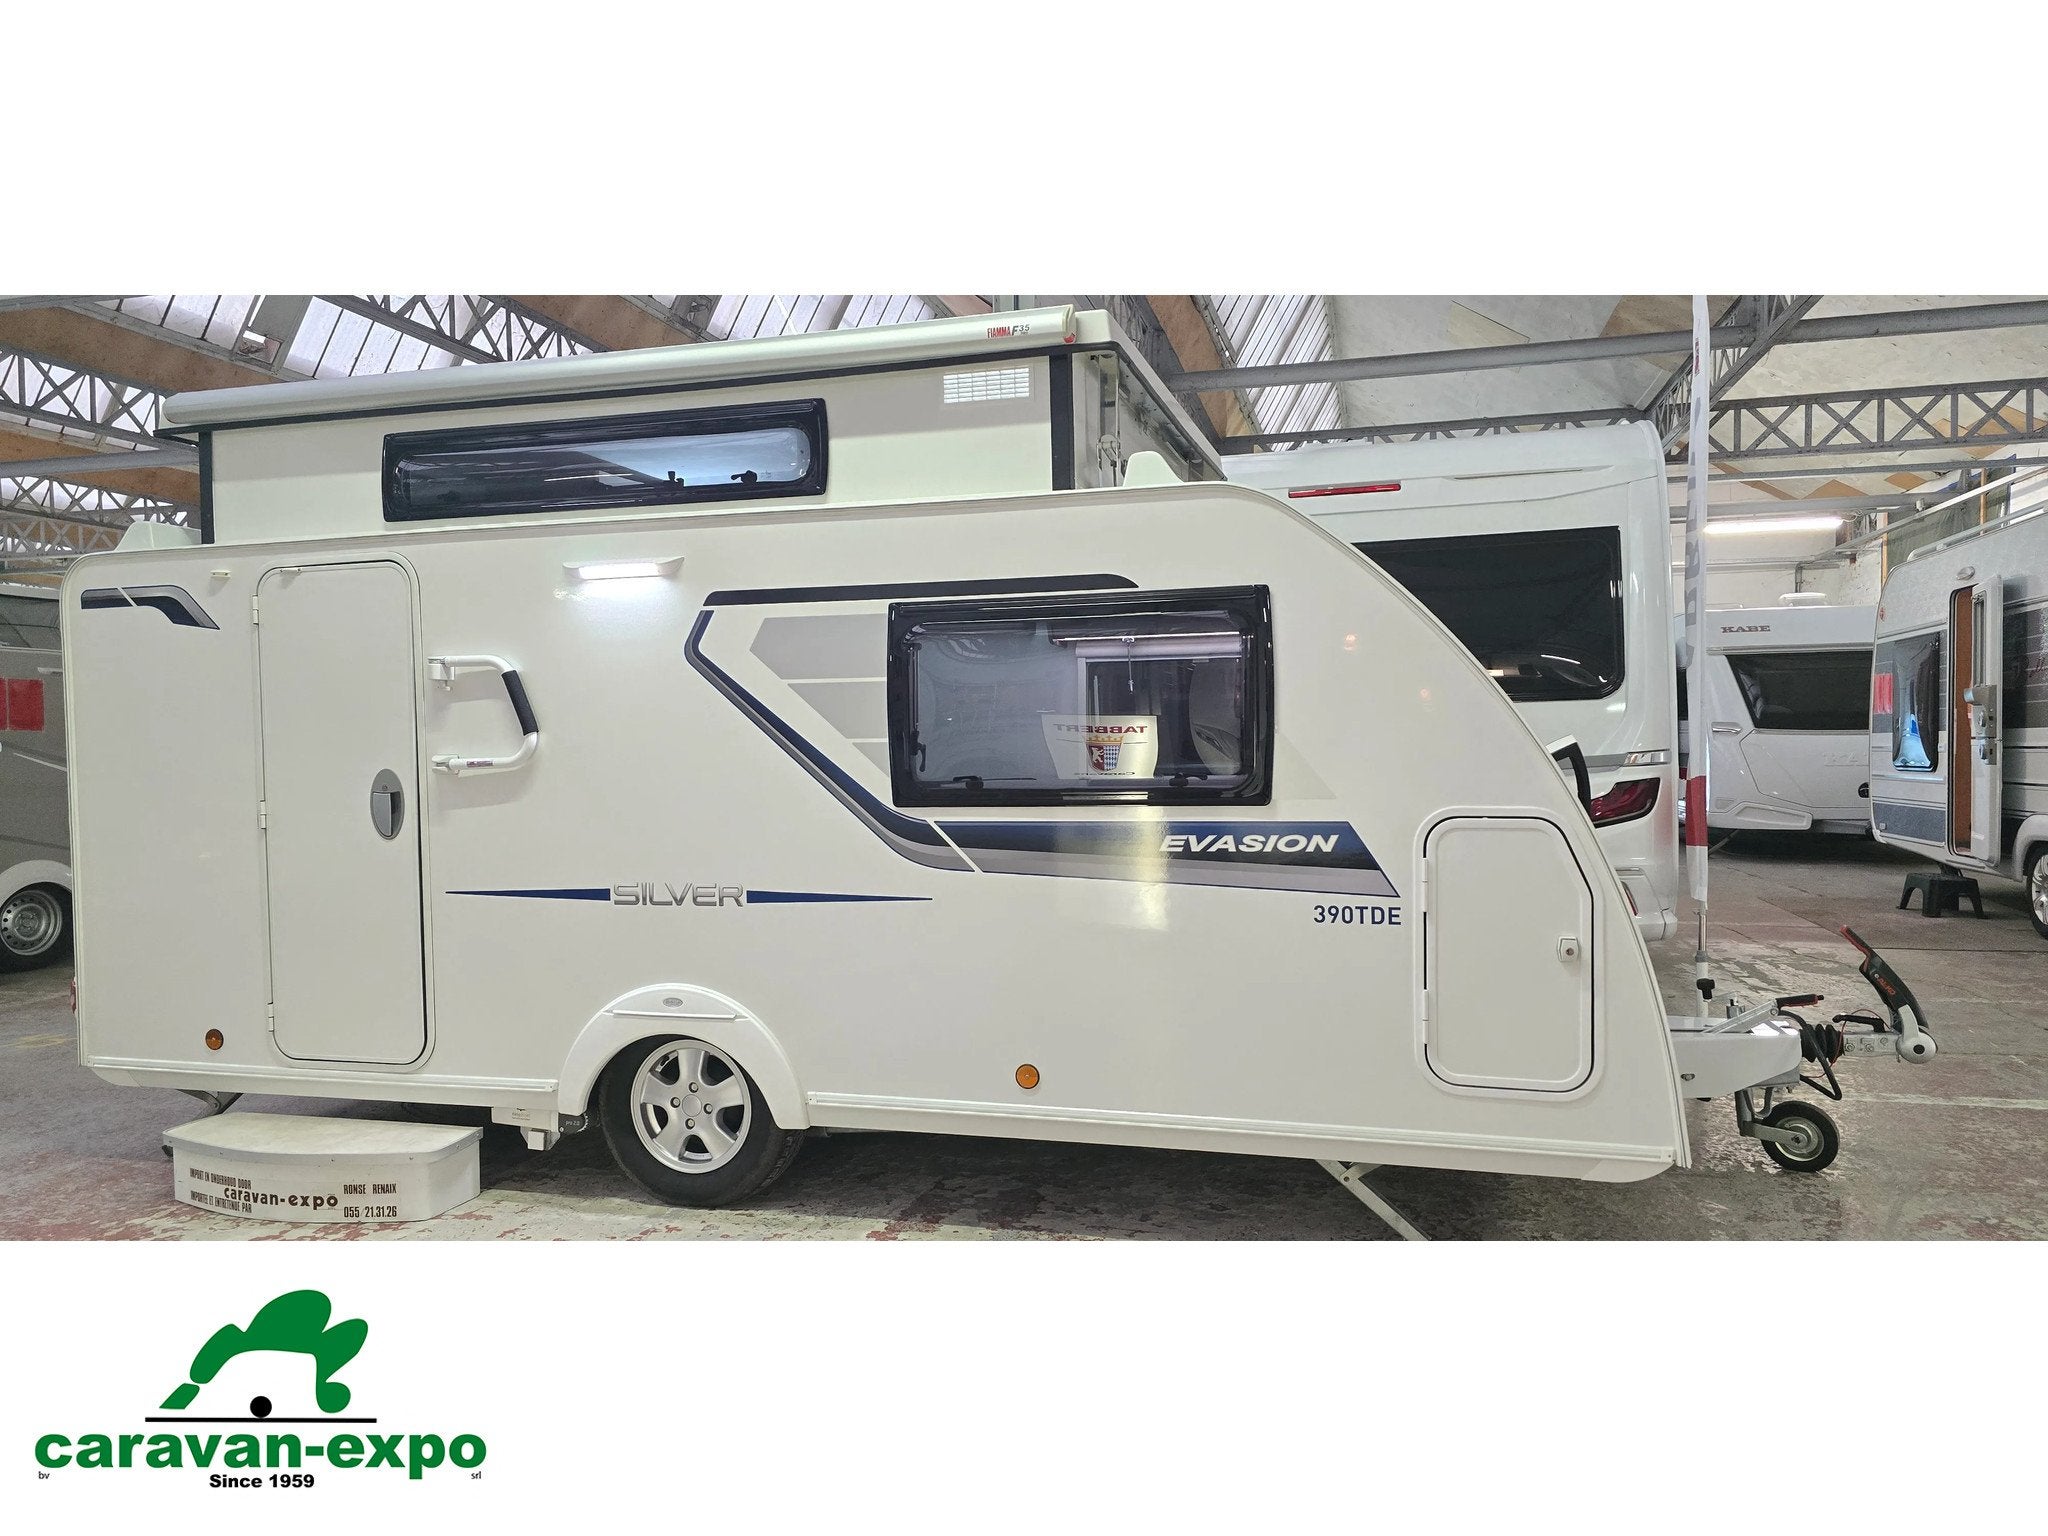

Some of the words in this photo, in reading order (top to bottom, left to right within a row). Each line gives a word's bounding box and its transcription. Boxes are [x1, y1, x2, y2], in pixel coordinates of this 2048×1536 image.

[986, 326, 1011, 339] FIAMMA
[1720, 625, 1771, 634] KABE
[1160, 834, 1339, 853] EVASION
[613, 882, 744, 907] SILVER
[1313, 905, 1402, 925] 390TDE
[237, 1178, 252, 1190] DOOR
[343, 1184, 366, 1195] RONSE
[372, 1183, 397, 1194] RENAIX
[223, 1187, 338, 1210] caravan-expo
[241, 1202, 252, 1213] PAR
